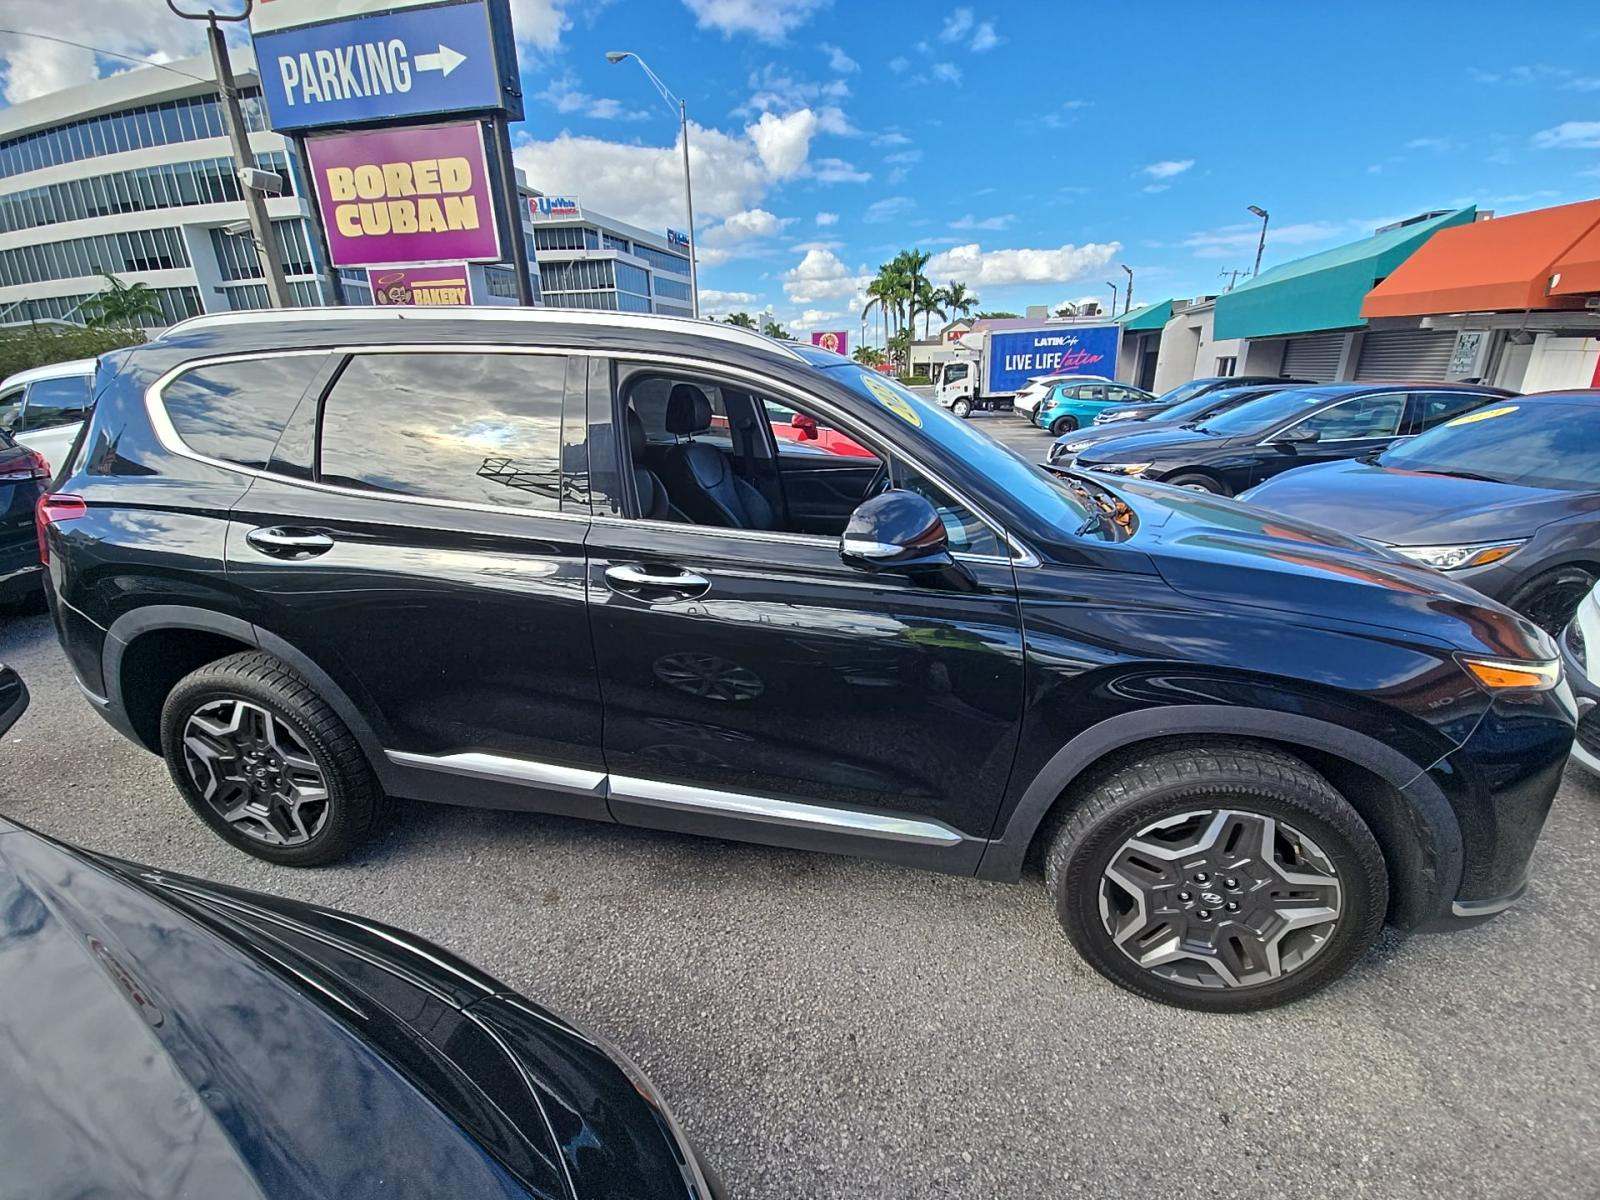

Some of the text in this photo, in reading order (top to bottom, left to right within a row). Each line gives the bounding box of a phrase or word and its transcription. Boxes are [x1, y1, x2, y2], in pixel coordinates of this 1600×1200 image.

[278, 39, 412, 106] PARKING
[326, 157, 473, 202] BORED
[335, 195, 480, 237] CUBAN
[413, 287, 466, 305] BAKERY
[1034, 336, 1064, 347] LATIN
[1005, 354, 1033, 371] LIVE
[1035, 352, 1062, 370] LIFE
